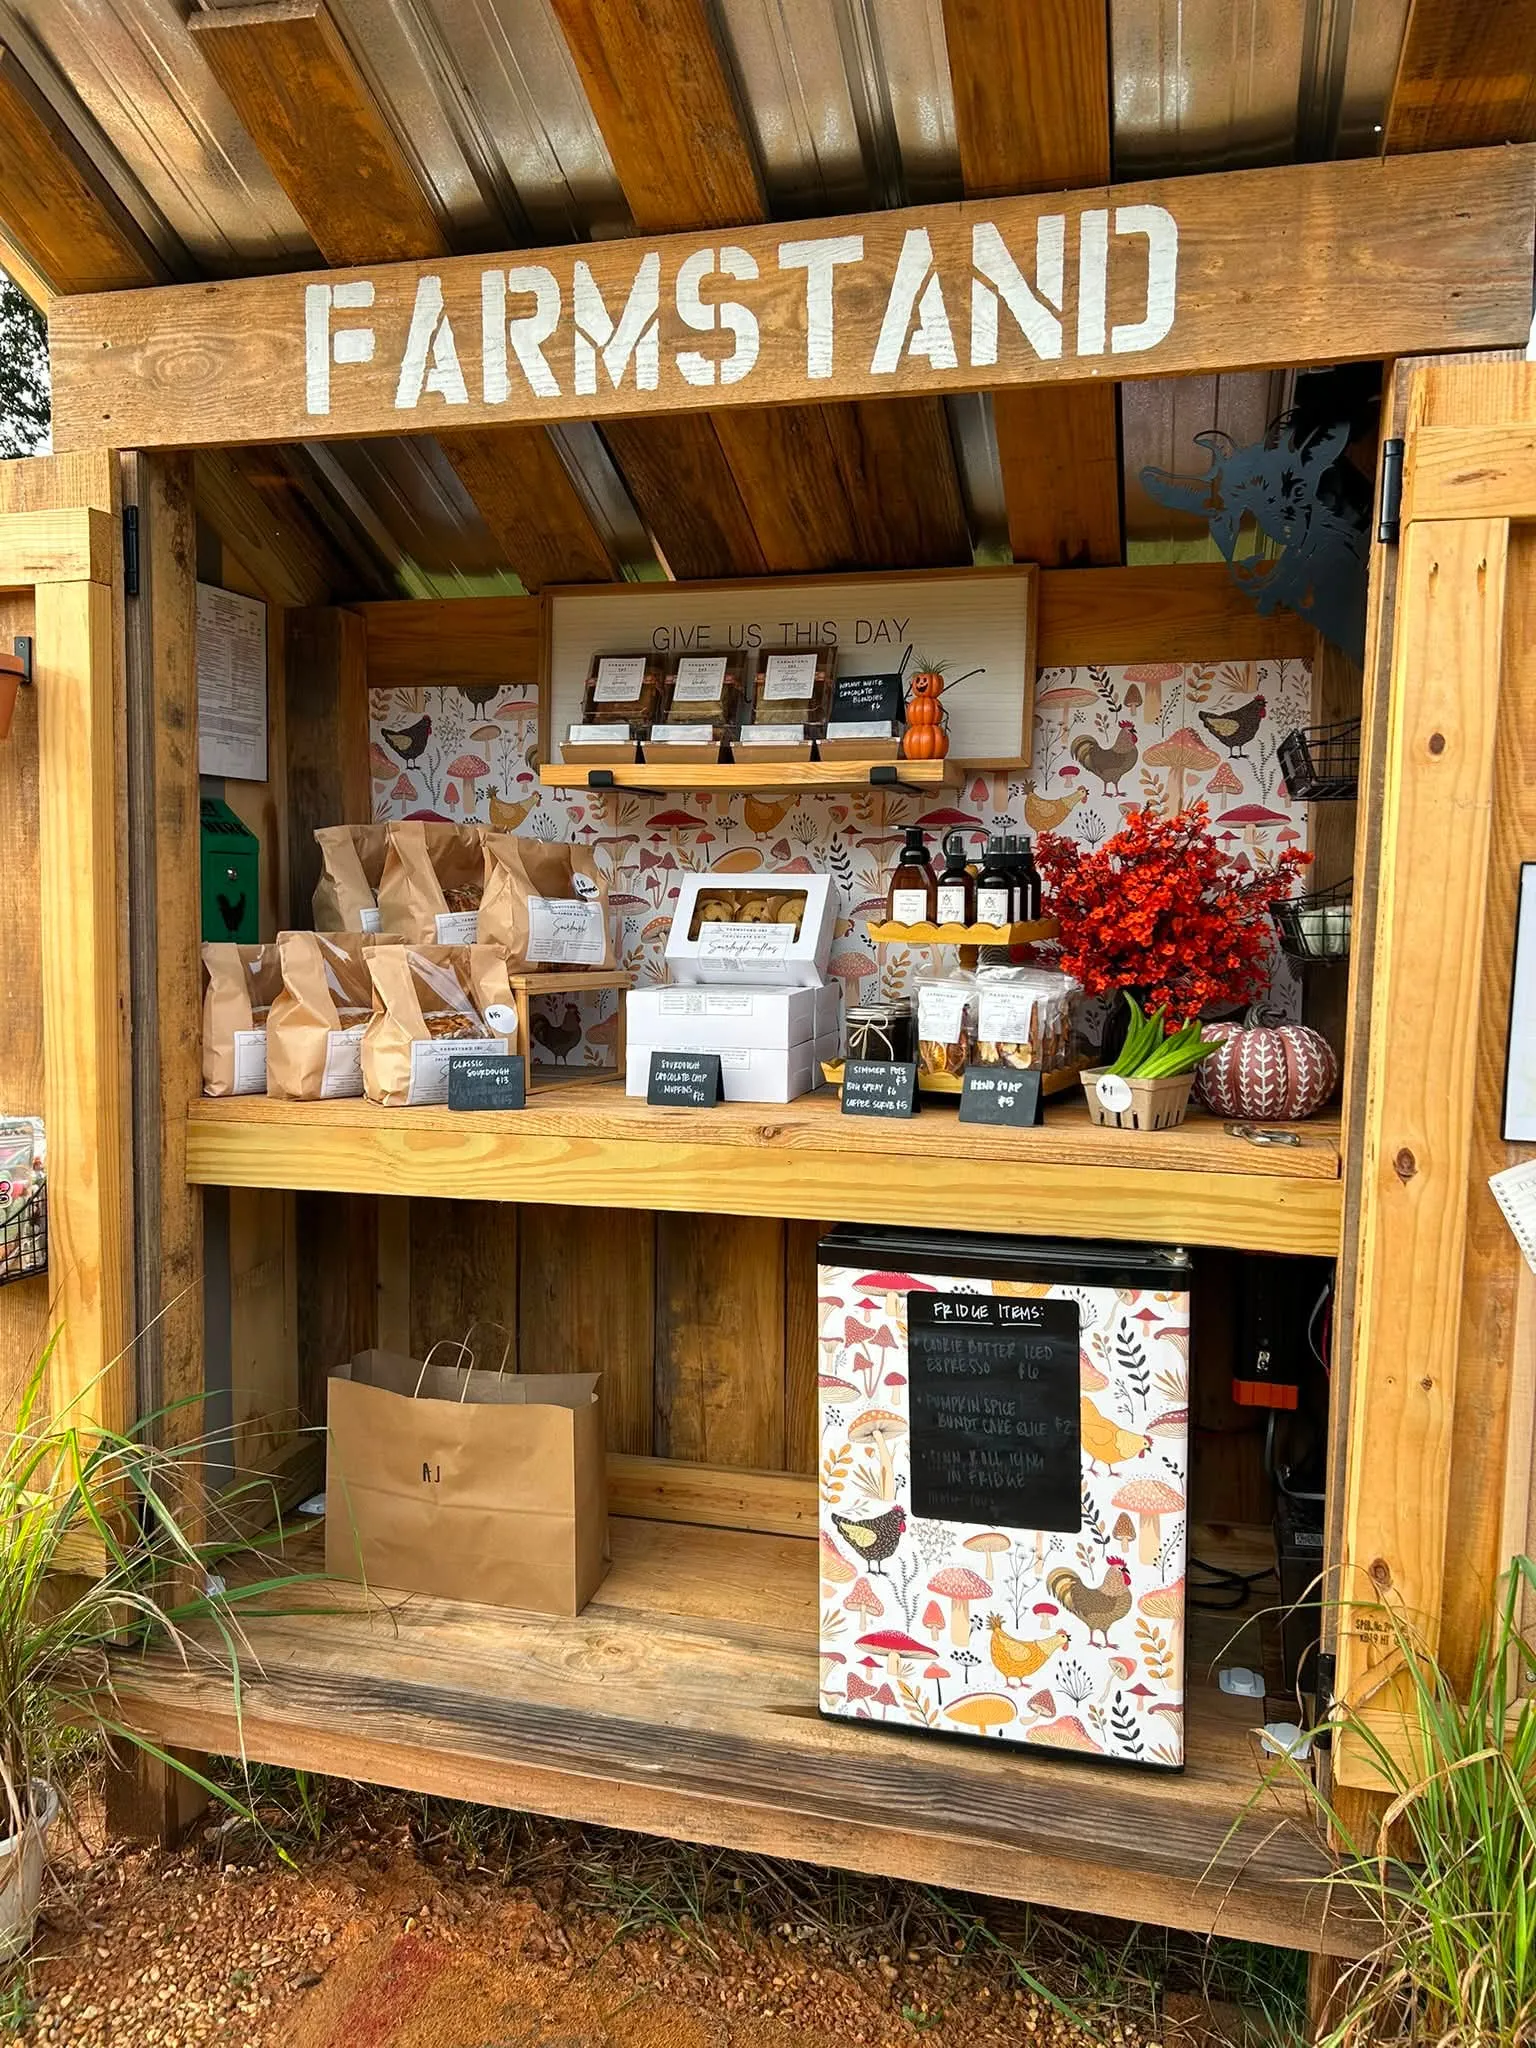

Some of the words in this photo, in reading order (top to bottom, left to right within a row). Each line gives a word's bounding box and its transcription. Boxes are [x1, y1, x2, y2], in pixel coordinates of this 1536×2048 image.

[304, 203, 1180, 416] FARMSTAND
[652, 624, 712, 650] GIVE
[727, 623, 763, 649] US
[778, 620, 838, 647] THIS
[855, 617, 911, 645] DAY
[452, 1058, 485, 1070] CLASSIC
[466, 1067, 511, 1079] SOURDOUGH
[853, 1065, 887, 1076] SIMMER
[495, 1076, 510, 1086] $13
[663, 1084, 693, 1094] MUFFINS
[861, 1082, 884, 1093] SPRAY
[997, 1095, 1015, 1108] $5
[933, 1302, 990, 1320] FRIDGE
[998, 1303, 1045, 1321] ITEMS:
